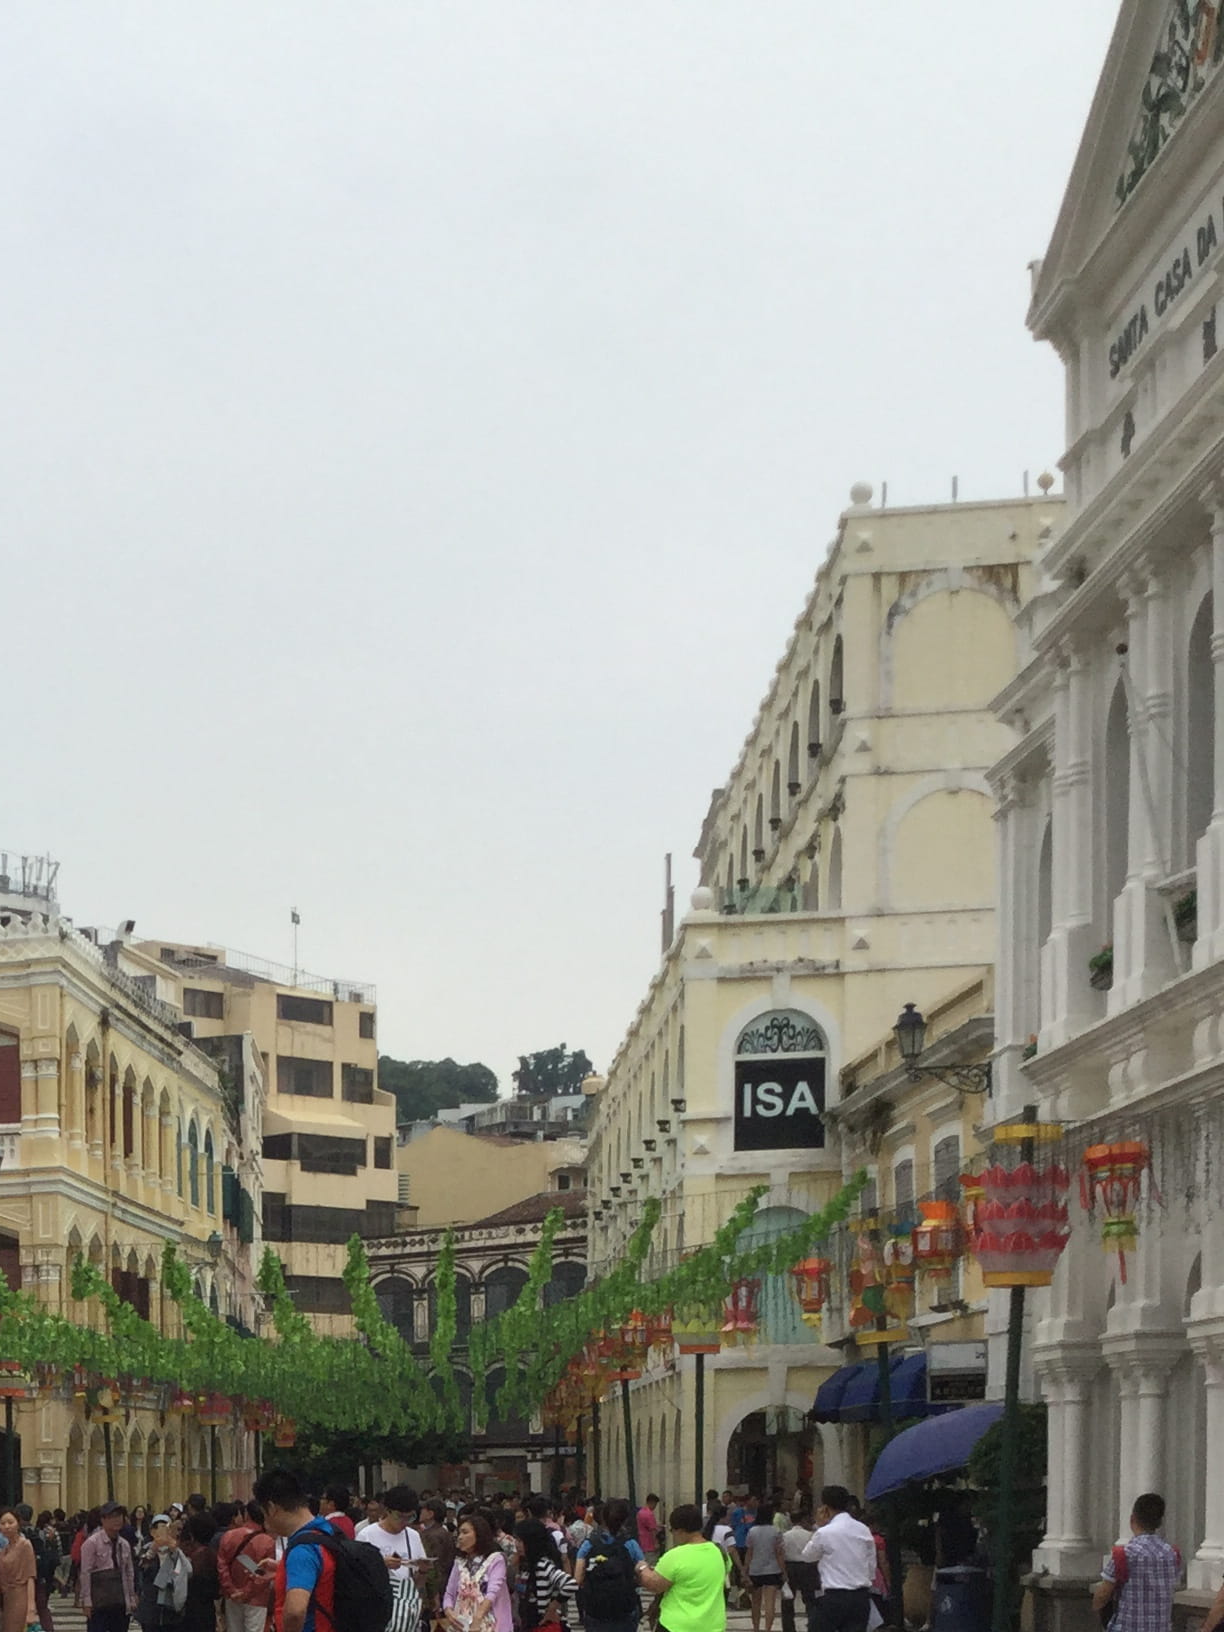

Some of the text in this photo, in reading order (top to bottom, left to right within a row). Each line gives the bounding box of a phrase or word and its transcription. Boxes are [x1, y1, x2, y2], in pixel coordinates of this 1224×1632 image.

[1109, 214, 1217, 379] SANTA CASA DA
[743, 1081, 819, 1118] ISA
